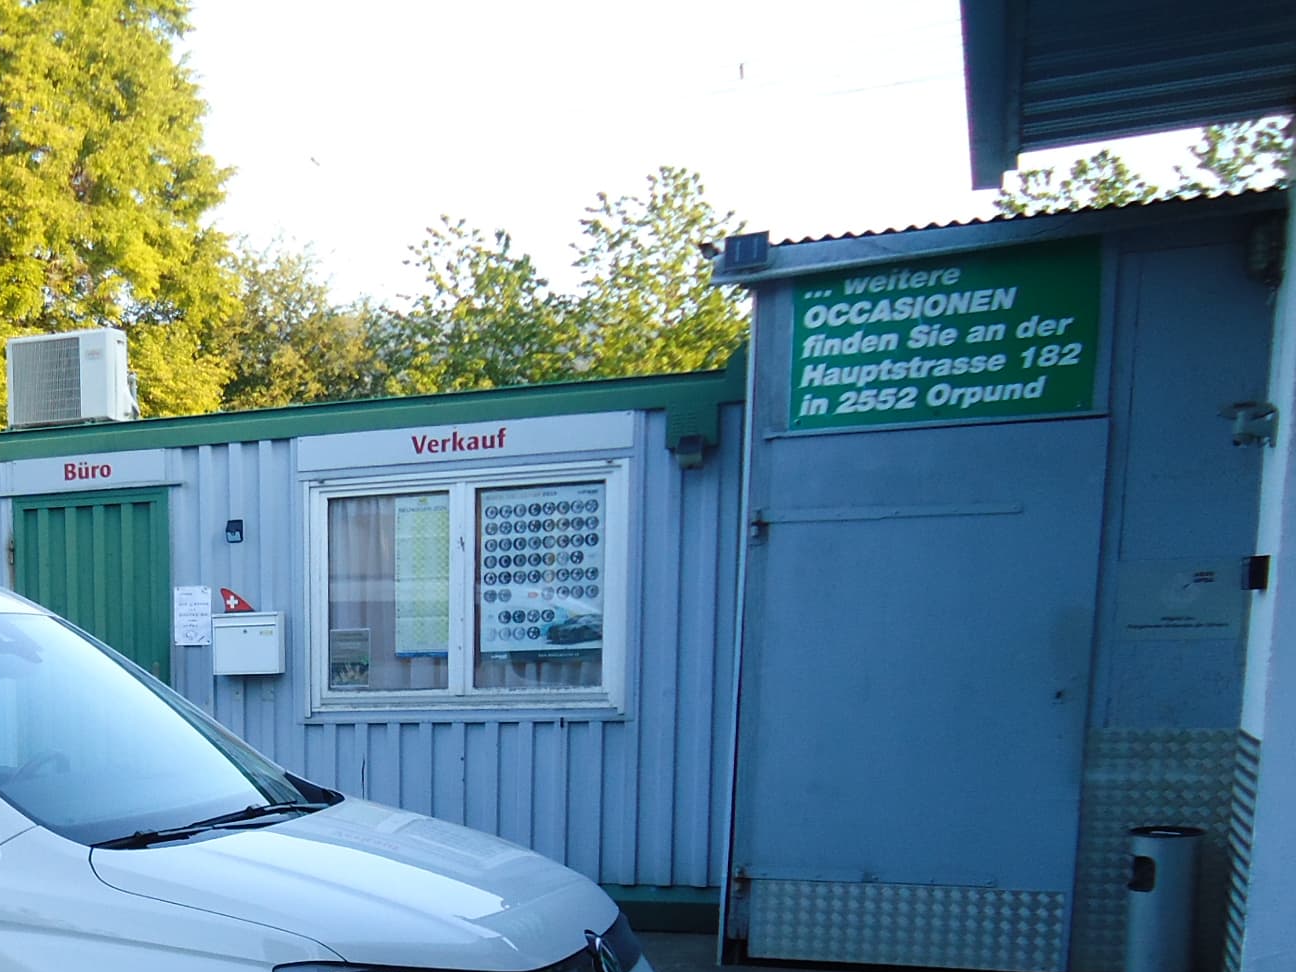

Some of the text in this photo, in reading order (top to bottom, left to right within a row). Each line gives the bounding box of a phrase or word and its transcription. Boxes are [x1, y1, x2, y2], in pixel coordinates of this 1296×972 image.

[844, 268, 960, 296] weitere
[804, 286, 1017, 329] OCCASIONEN
[801, 314, 1074, 359] finden Sie an der
[799, 342, 1082, 388] Hauptstrasse 182
[799, 375, 1047, 417] in 2552 Orpund
[411, 427, 507, 455] Verkauf
[64, 461, 112, 481] Büro
